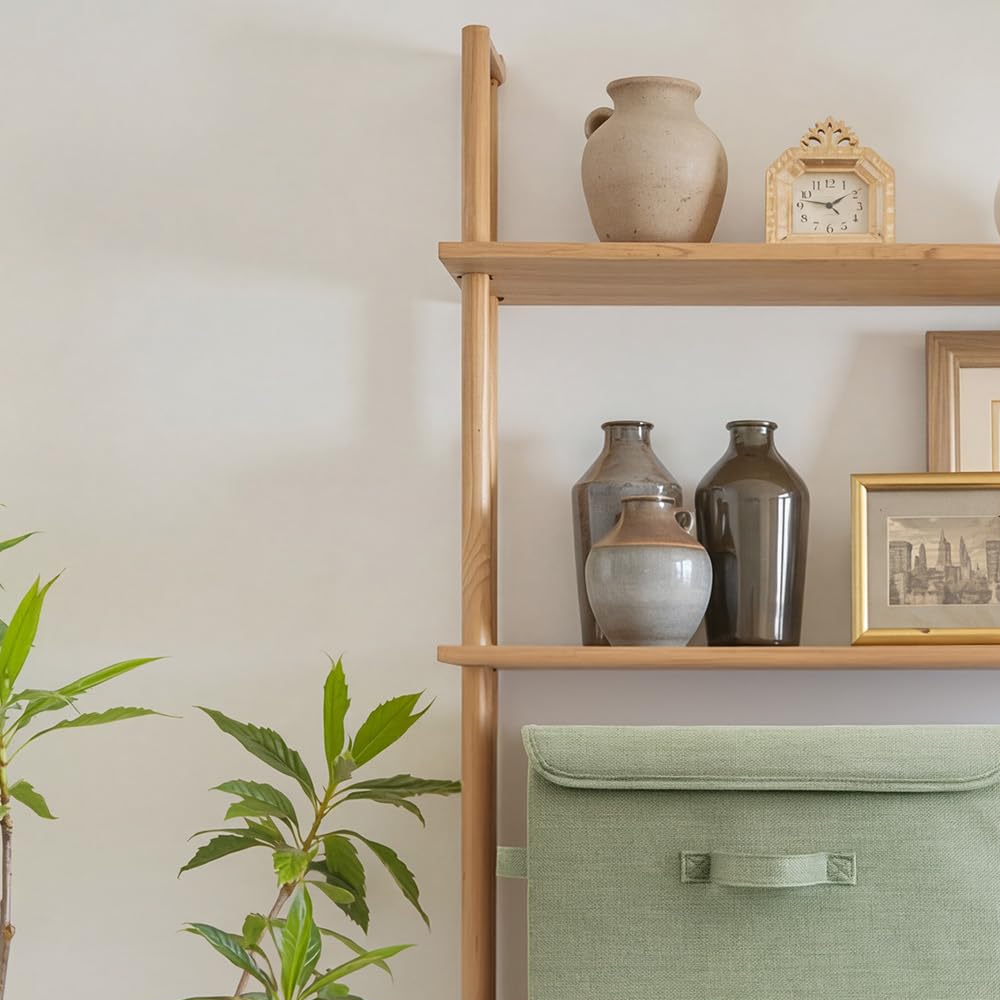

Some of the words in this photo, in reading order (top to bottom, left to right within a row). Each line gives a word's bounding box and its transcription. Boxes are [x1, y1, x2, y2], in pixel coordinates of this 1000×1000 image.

[812, 180, 821, 191] 11
[825, 179, 836, 189] 12
[800, 190, 812, 199] 10
[851, 190, 859, 200] 2
[796, 201, 804, 210] 9
[856, 201, 863, 211] 3
[800, 214, 808, 223] 8
[812, 221, 820, 231] 7
[826, 223, 834, 234] 6
[840, 221, 848, 231] 5
